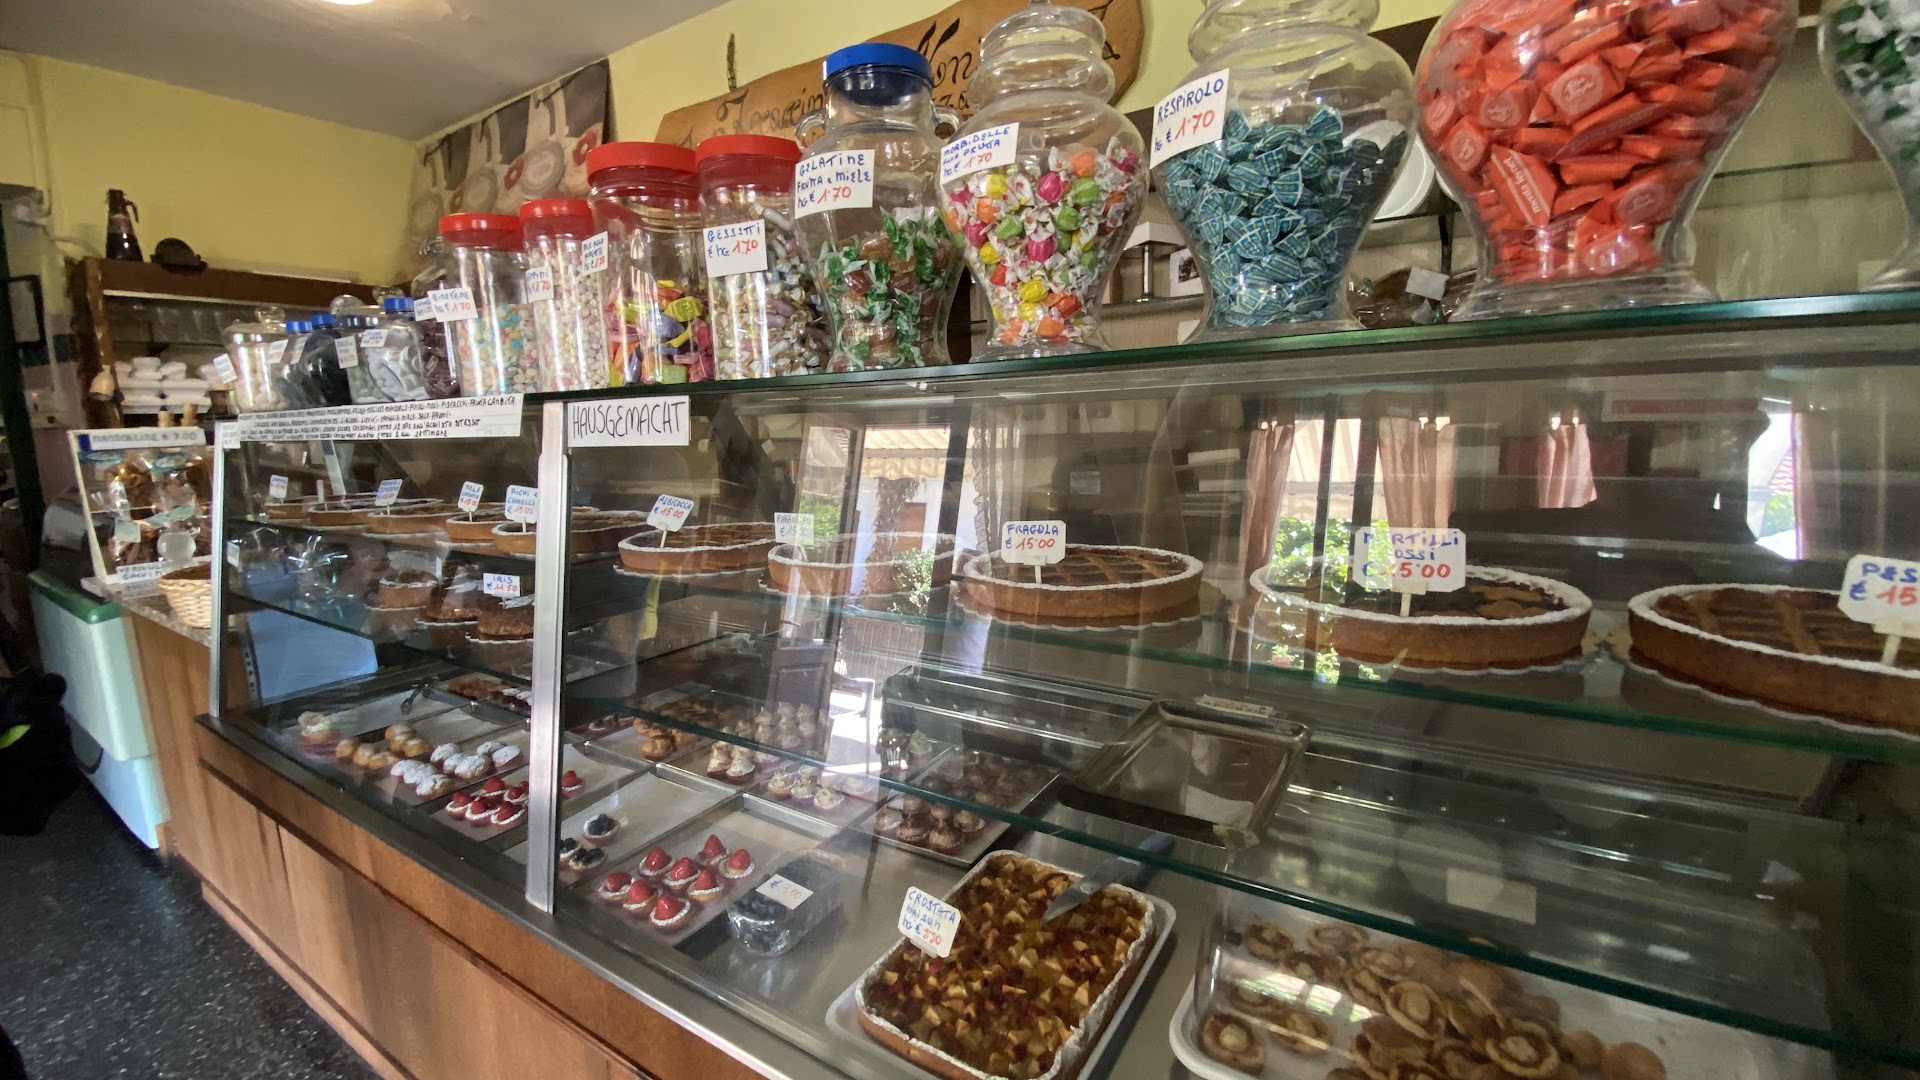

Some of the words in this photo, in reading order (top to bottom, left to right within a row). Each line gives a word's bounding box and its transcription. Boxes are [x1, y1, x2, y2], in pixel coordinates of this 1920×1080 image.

[1157, 79, 1224, 125] RESPIROLO
[1166, 128, 1172, 143] €
[954, 161, 961, 172] €
[809, 191, 815, 202] €
[1521, 184, 1541, 213] menta
[707, 245, 713, 258] €
[573, 401, 686, 438] HAUSGEMACHT
[1007, 524, 1058, 535] FRAGOLA
[1005, 537, 1012, 549] €
[1850, 580, 1867, 601] €
[909, 891, 955, 924] CROSTATA
[915, 924, 921, 934] €
